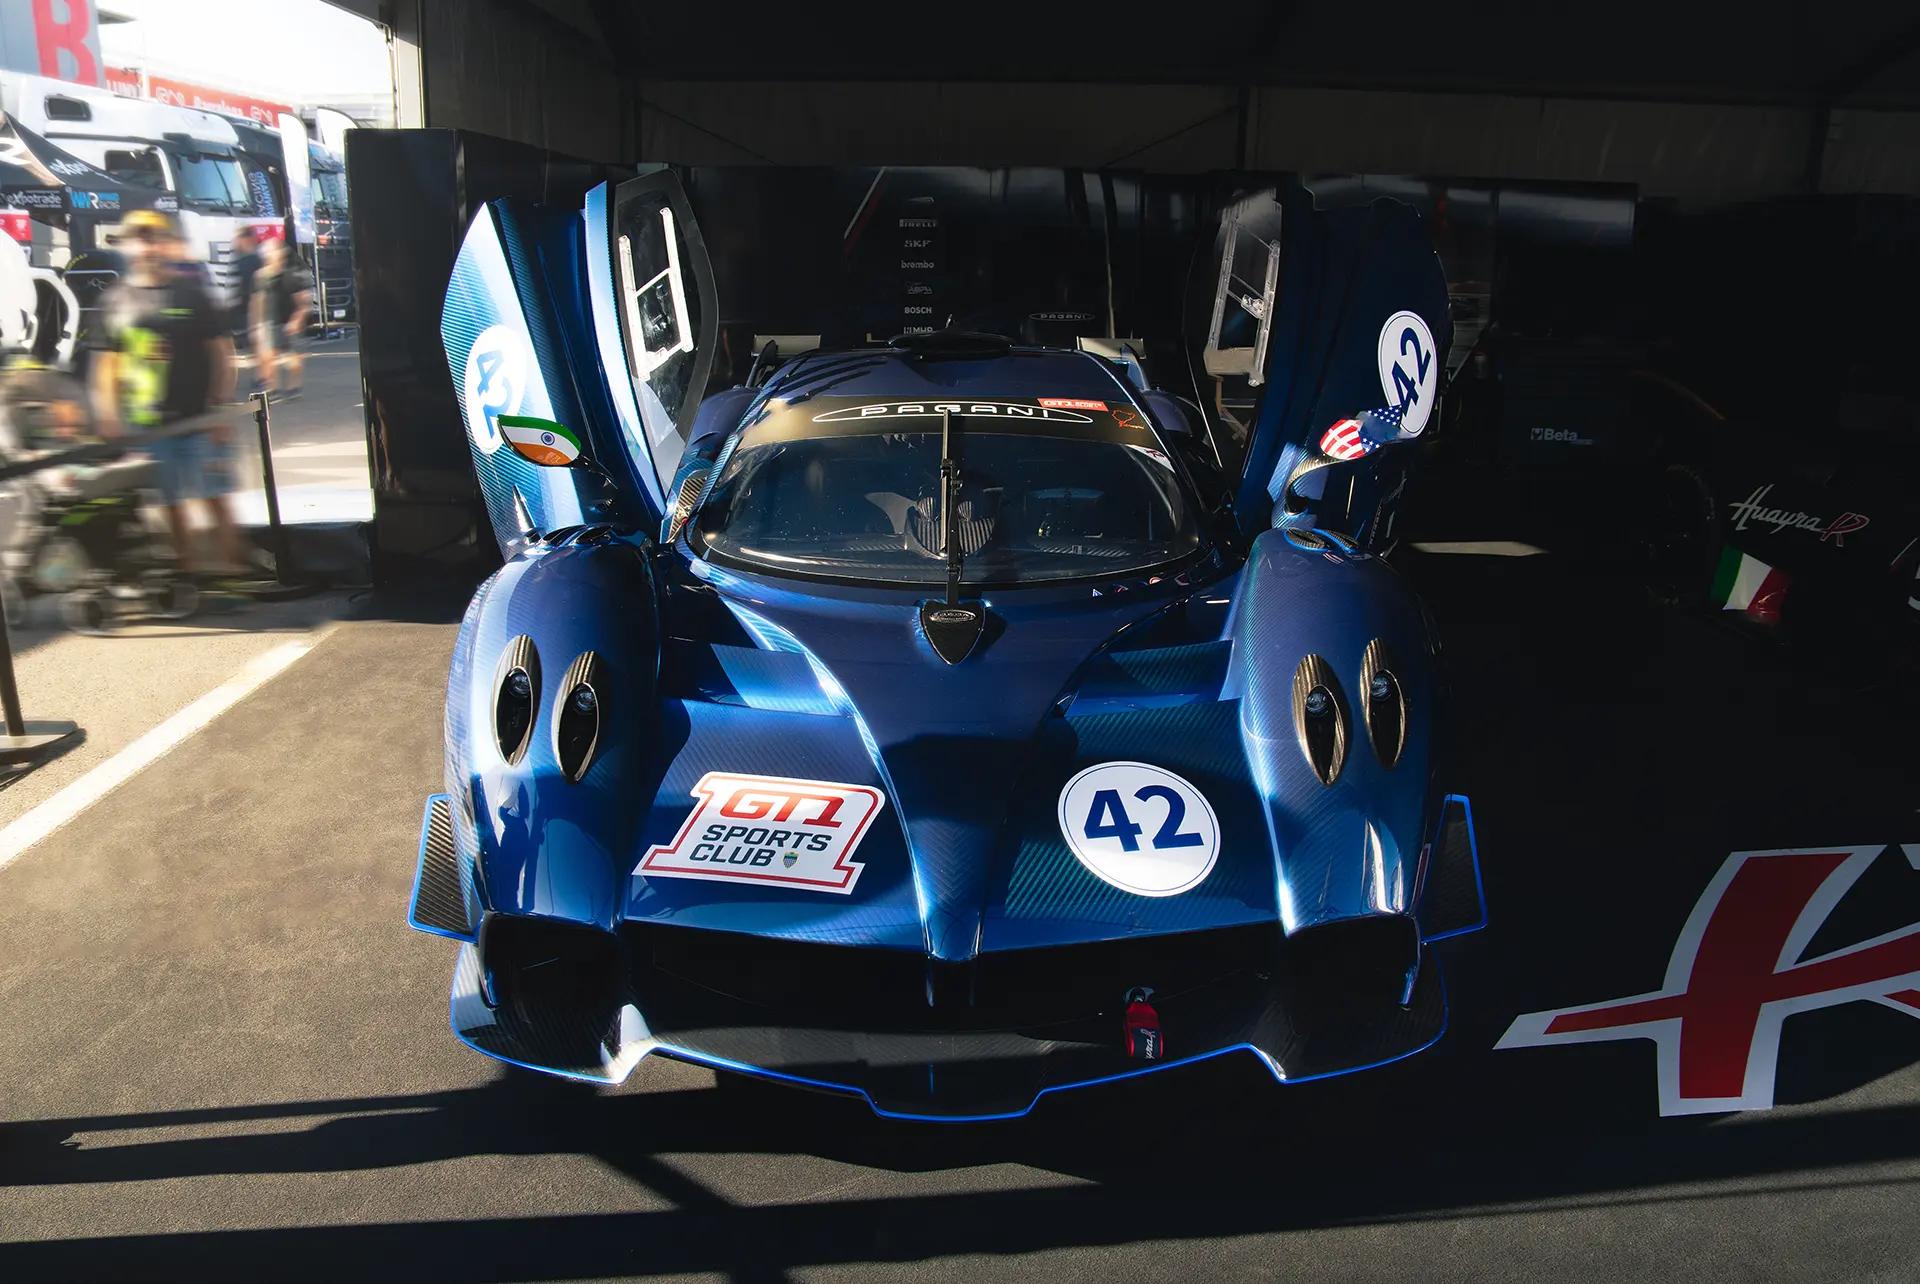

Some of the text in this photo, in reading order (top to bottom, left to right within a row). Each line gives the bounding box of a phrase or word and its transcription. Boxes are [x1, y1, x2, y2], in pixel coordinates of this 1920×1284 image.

[899, 219, 937, 228] PIRELLI
[901, 260, 935, 269] brembo
[1391, 327, 1432, 418] 42
[860, 404, 1050, 419] PAGANI
[1544, 427, 1579, 441] Beta
[1728, 484, 1823, 535] Huayra
[719, 787, 845, 828] GT1
[1083, 784, 1205, 853] 42
[702, 824, 832, 851] SPORTS
[689, 844, 776, 867] CLUB
